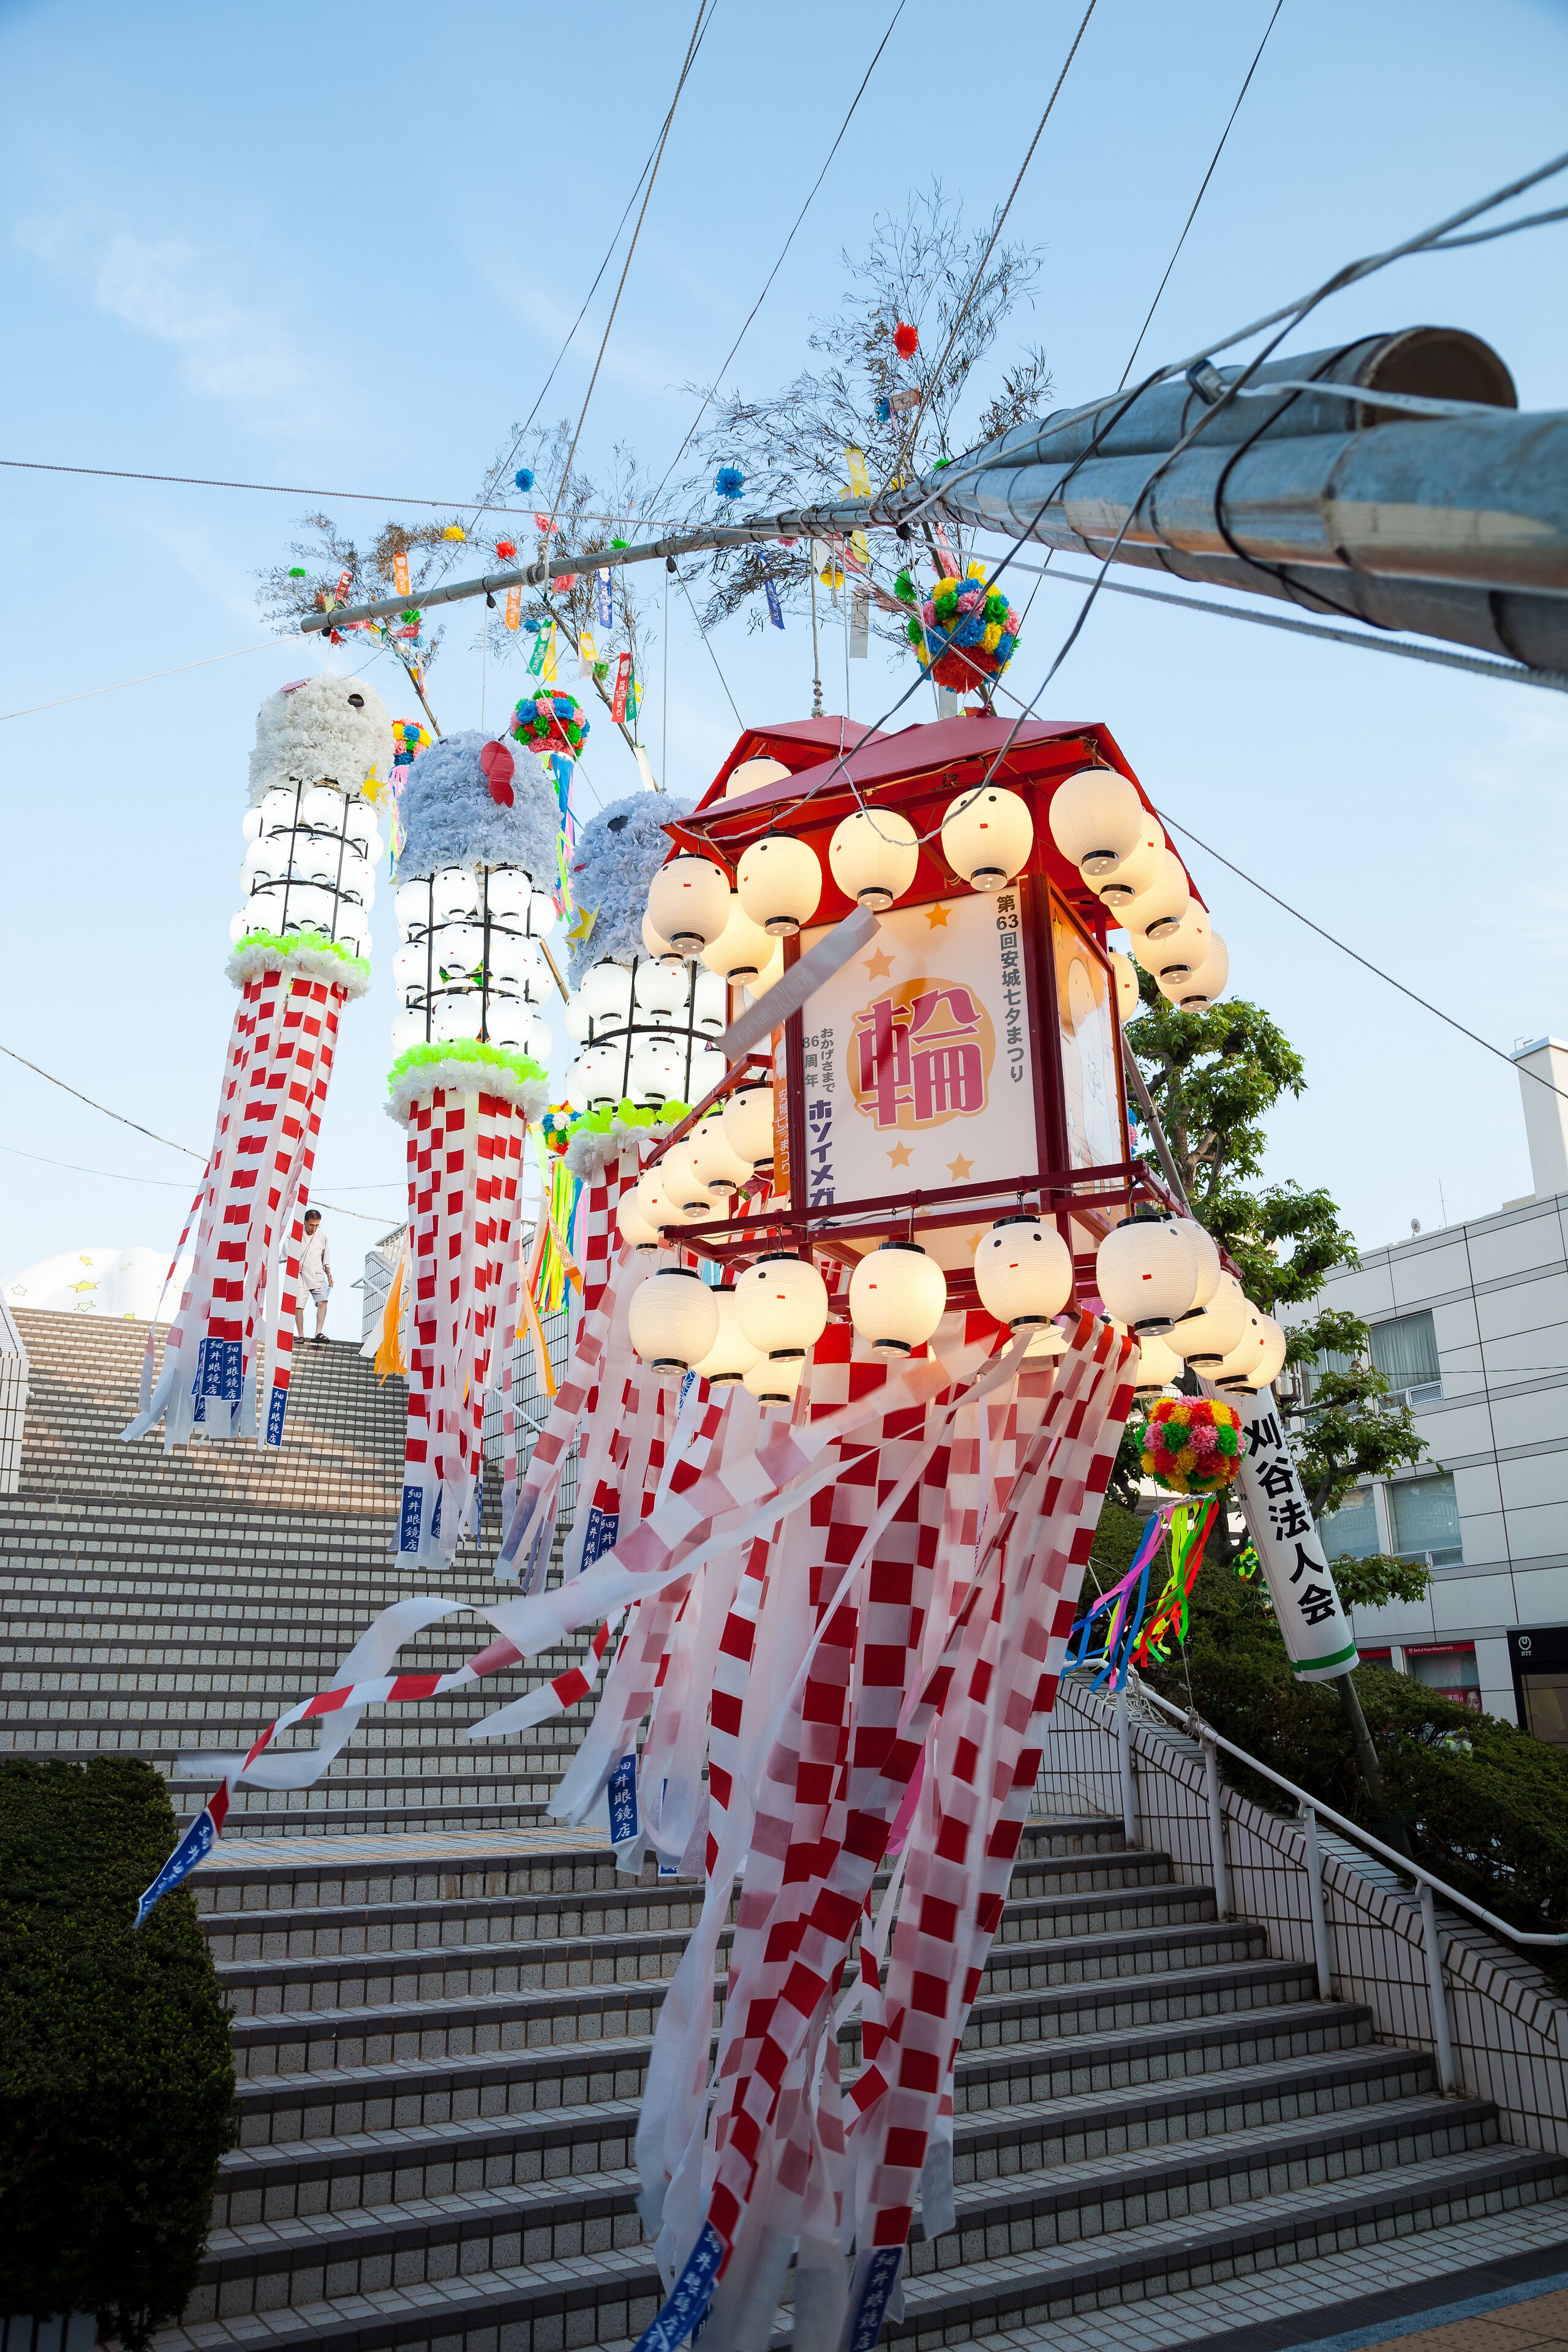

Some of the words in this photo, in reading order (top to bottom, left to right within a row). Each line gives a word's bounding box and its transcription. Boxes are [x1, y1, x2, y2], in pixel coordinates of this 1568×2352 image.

[997, 894, 1024, 1083] 第63回安城七夕まつり
[802, 1035, 820, 1088] 86周年
[820, 1028, 835, 1093] おかげさまで
[858, 988, 981, 1126] 輪
[205, 1341, 223, 1394] 細井眼鏡店
[225, 1345, 239, 1398] 細井眼鏡店
[268, 1391, 284, 1444] 細井眼鏡店
[405, 1489, 422, 1552] 細井眼鏡店
[1243, 1413, 1336, 1626] 刈谷法人会
